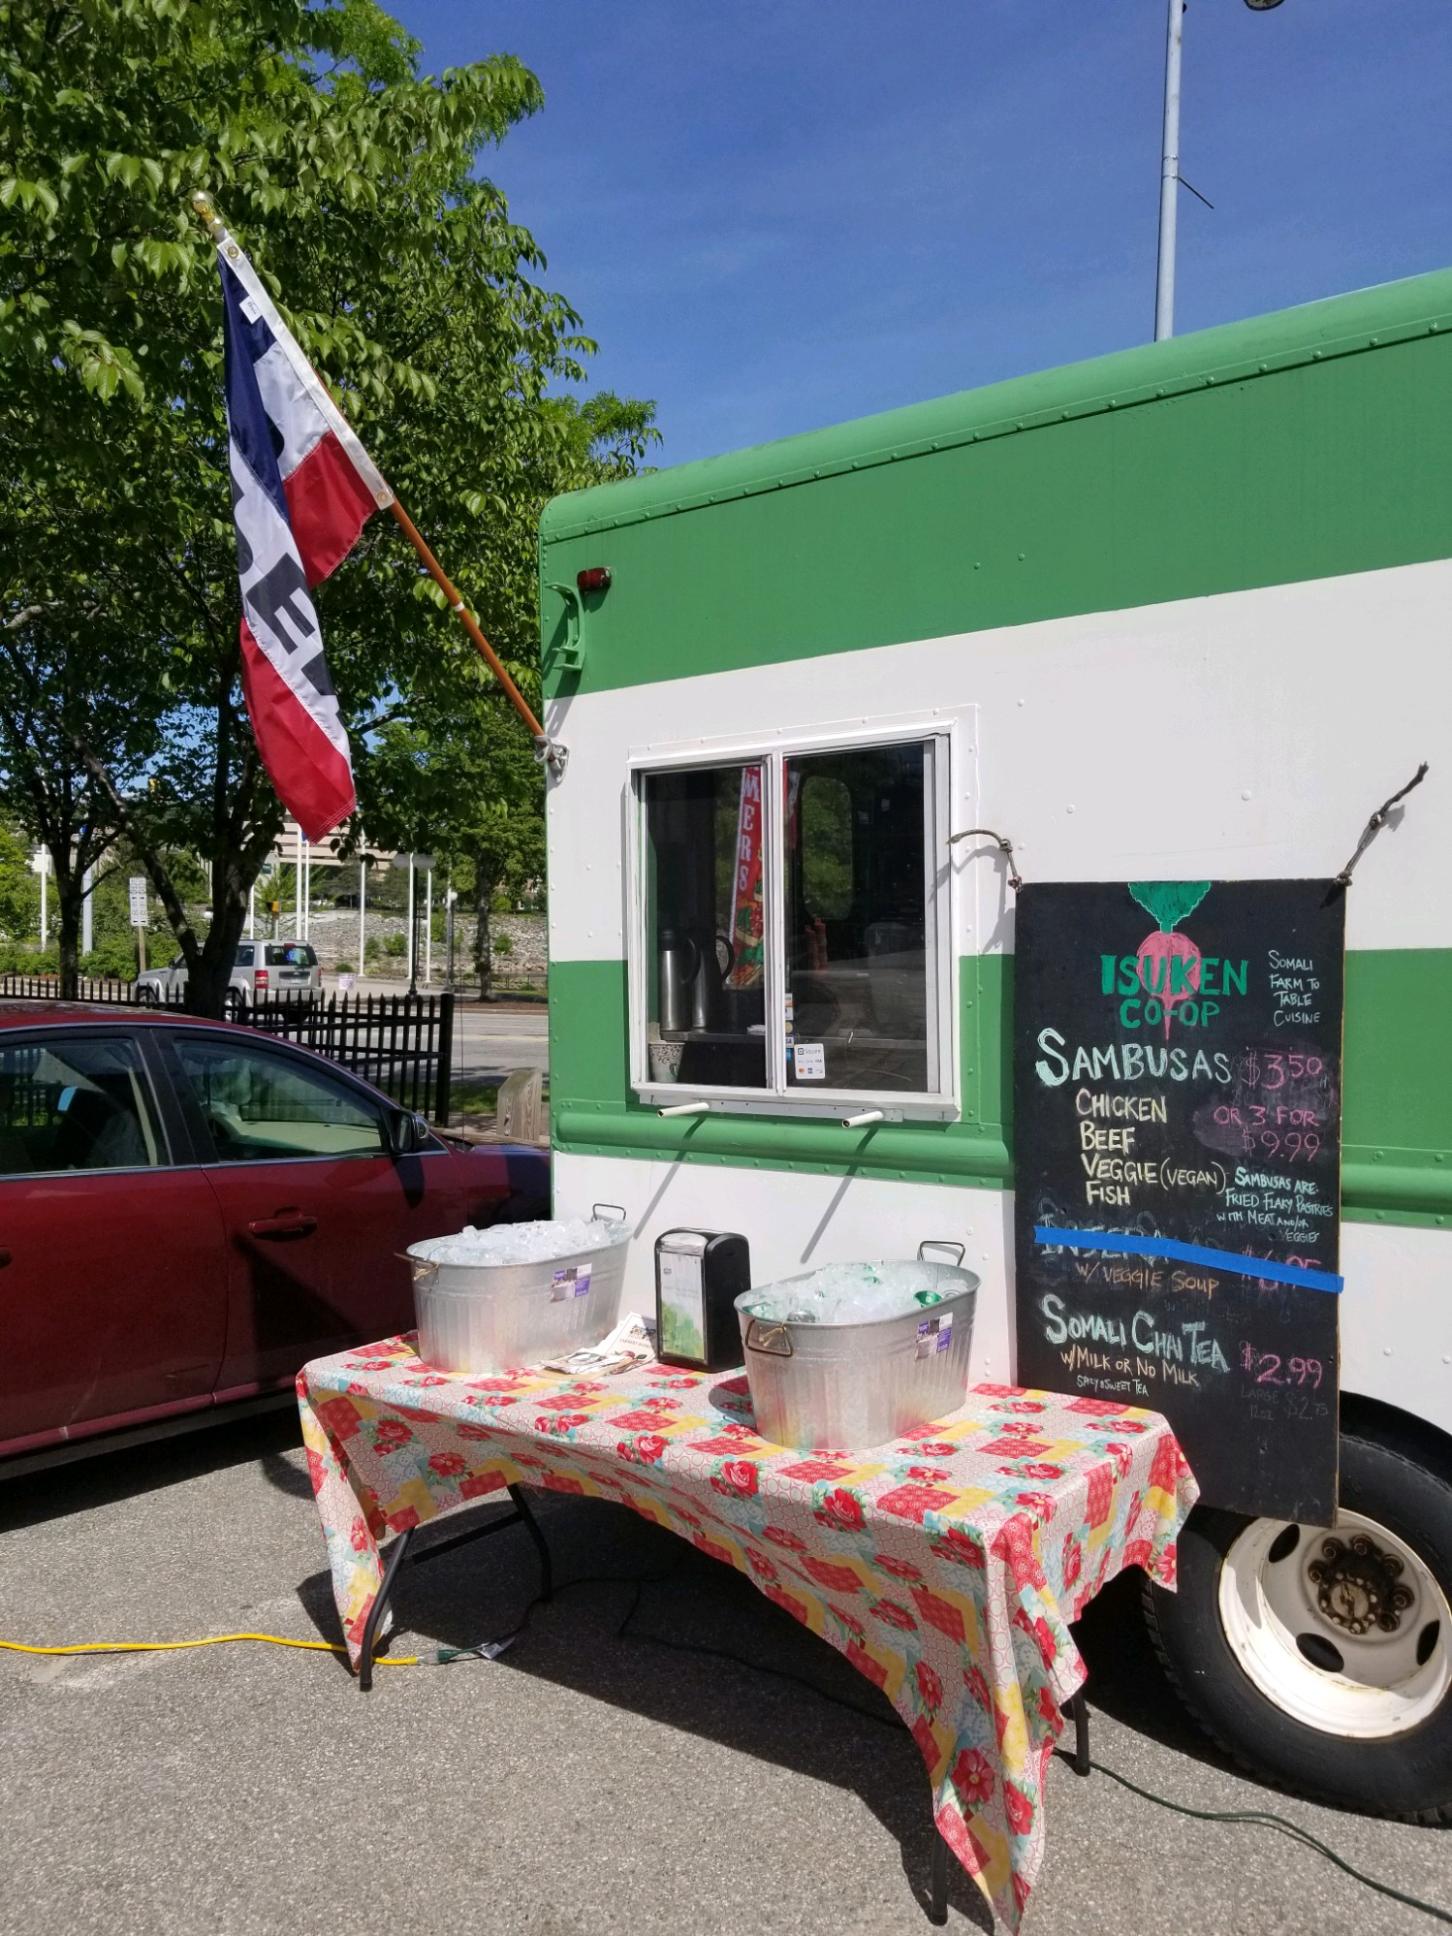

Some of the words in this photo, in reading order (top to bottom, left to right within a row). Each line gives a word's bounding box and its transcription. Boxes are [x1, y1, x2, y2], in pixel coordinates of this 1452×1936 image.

[1268, 950, 1313, 971] SOMALI
[1100, 954, 1248, 995] ISUKEN
[1270, 974, 1303, 991] FARM
[1273, 991, 1313, 1007] TABLE
[1119, 998, 1220, 1028] CO-OP
[1273, 1010, 1321, 1027] CUISINE
[1036, 1027, 1232, 1087] SAMBUSAS
[1075, 1087, 1168, 1123] CHICKEN
[1213, 1105, 1242, 1126] OR
[1248, 1105, 1266, 1126] 3
[1276, 1106, 1320, 1127] FOR
[1080, 1121, 1135, 1153] BEEF
[1080, 1153, 1158, 1184] VEGGIE
[1160, 1157, 1227, 1195] (VEGAN)
[1234, 1166, 1291, 1191] SAMBUSAS
[1085, 1181, 1131, 1206] FISH
[1225, 1187, 1260, 1207] FRIED
[1264, 1192, 1294, 1214] FLAKY
[1296, 1194, 1334, 1217] PASTRIES
[1216, 1211, 1243, 1222] WITH
[1248, 1210, 1276, 1225] MEAT
[1102, 1266, 1164, 1289] VEGGIE
[1040, 1294, 1127, 1347] SOMALI
[1132, 1310, 1183, 1363] CHAI
[1182, 1320, 1230, 1373] TEA
[1162, 1359, 1200, 1388] MILK
[1240, 1341, 1322, 1389] $2.99
[1132, 1378, 1149, 1397] TEA
